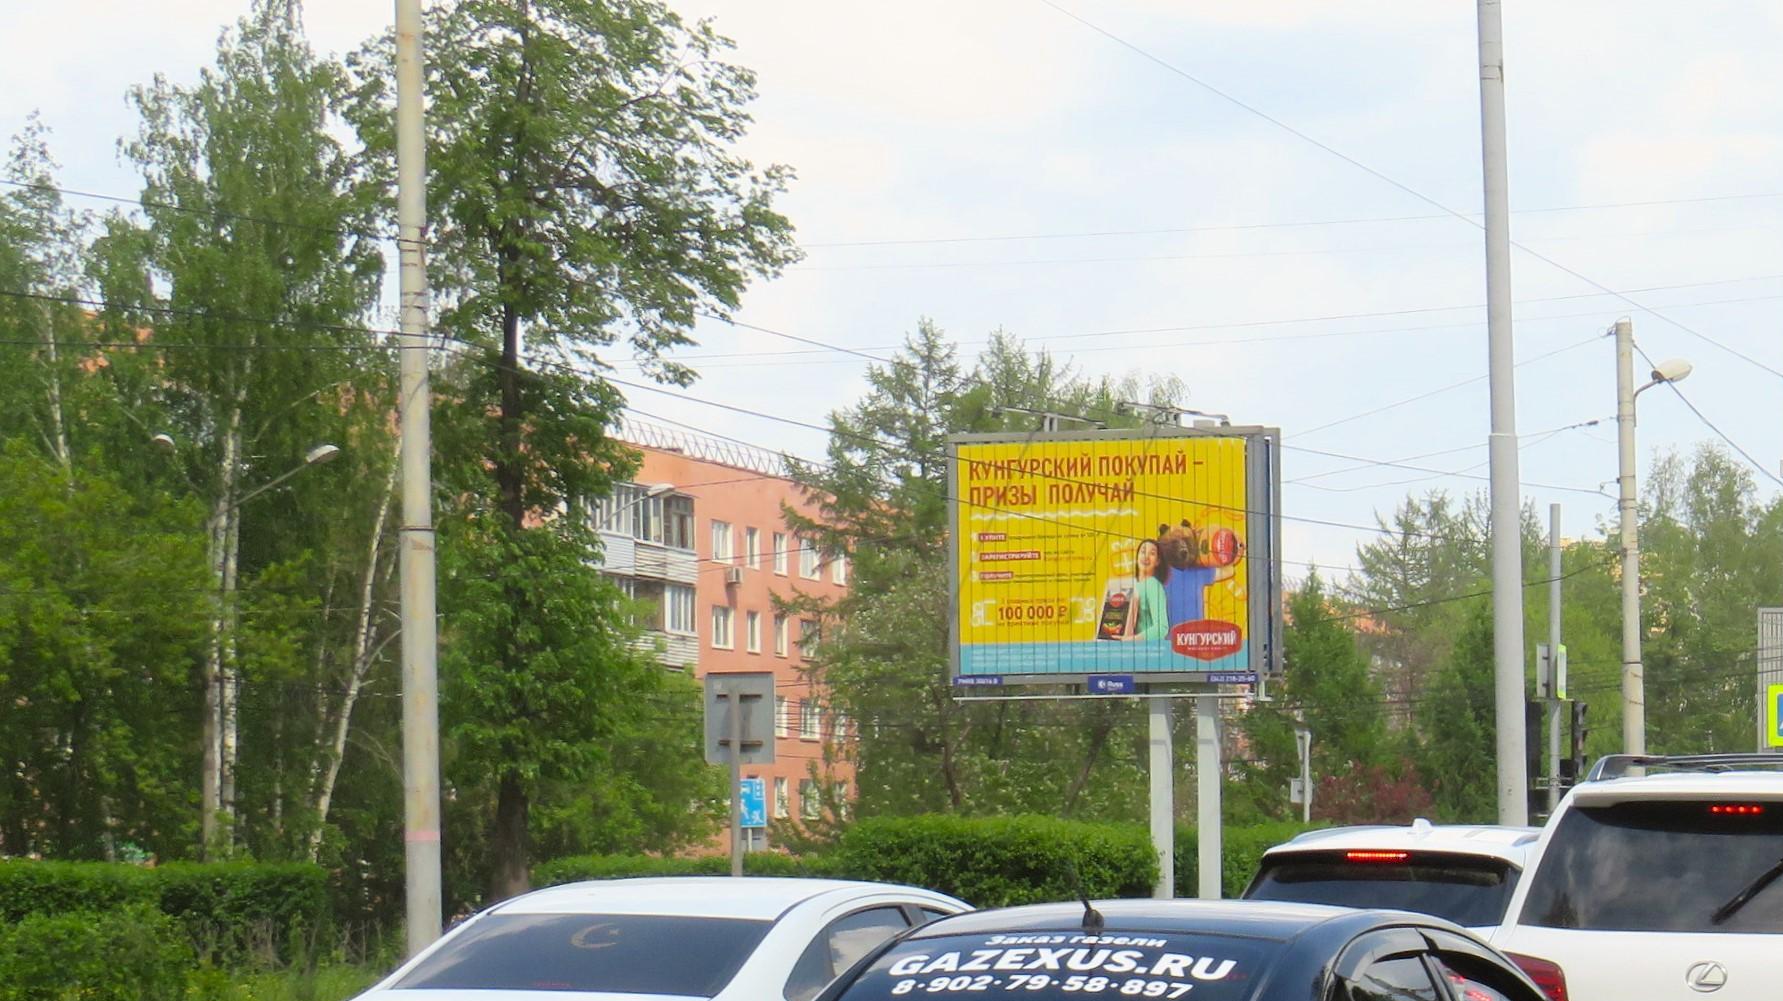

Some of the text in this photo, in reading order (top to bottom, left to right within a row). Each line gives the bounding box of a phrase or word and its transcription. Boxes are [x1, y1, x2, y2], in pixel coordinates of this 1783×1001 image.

[969, 452, 1092, 481] КУНГУРСКИЙ
[1099, 450, 1187, 478] ПОКУПАЙ
[969, 478, 1135, 507] ПРИЗЫ ПОЛУЧАЙ
[998, 606, 1023, 620] 100
[1028, 605, 1054, 619] 000
[1176, 629, 1237, 646] КУНГУРСКИЙ
[985, 934, 1168, 948] Заказ газели
[888, 948, 1237, 981] GAZEXUS.RU
